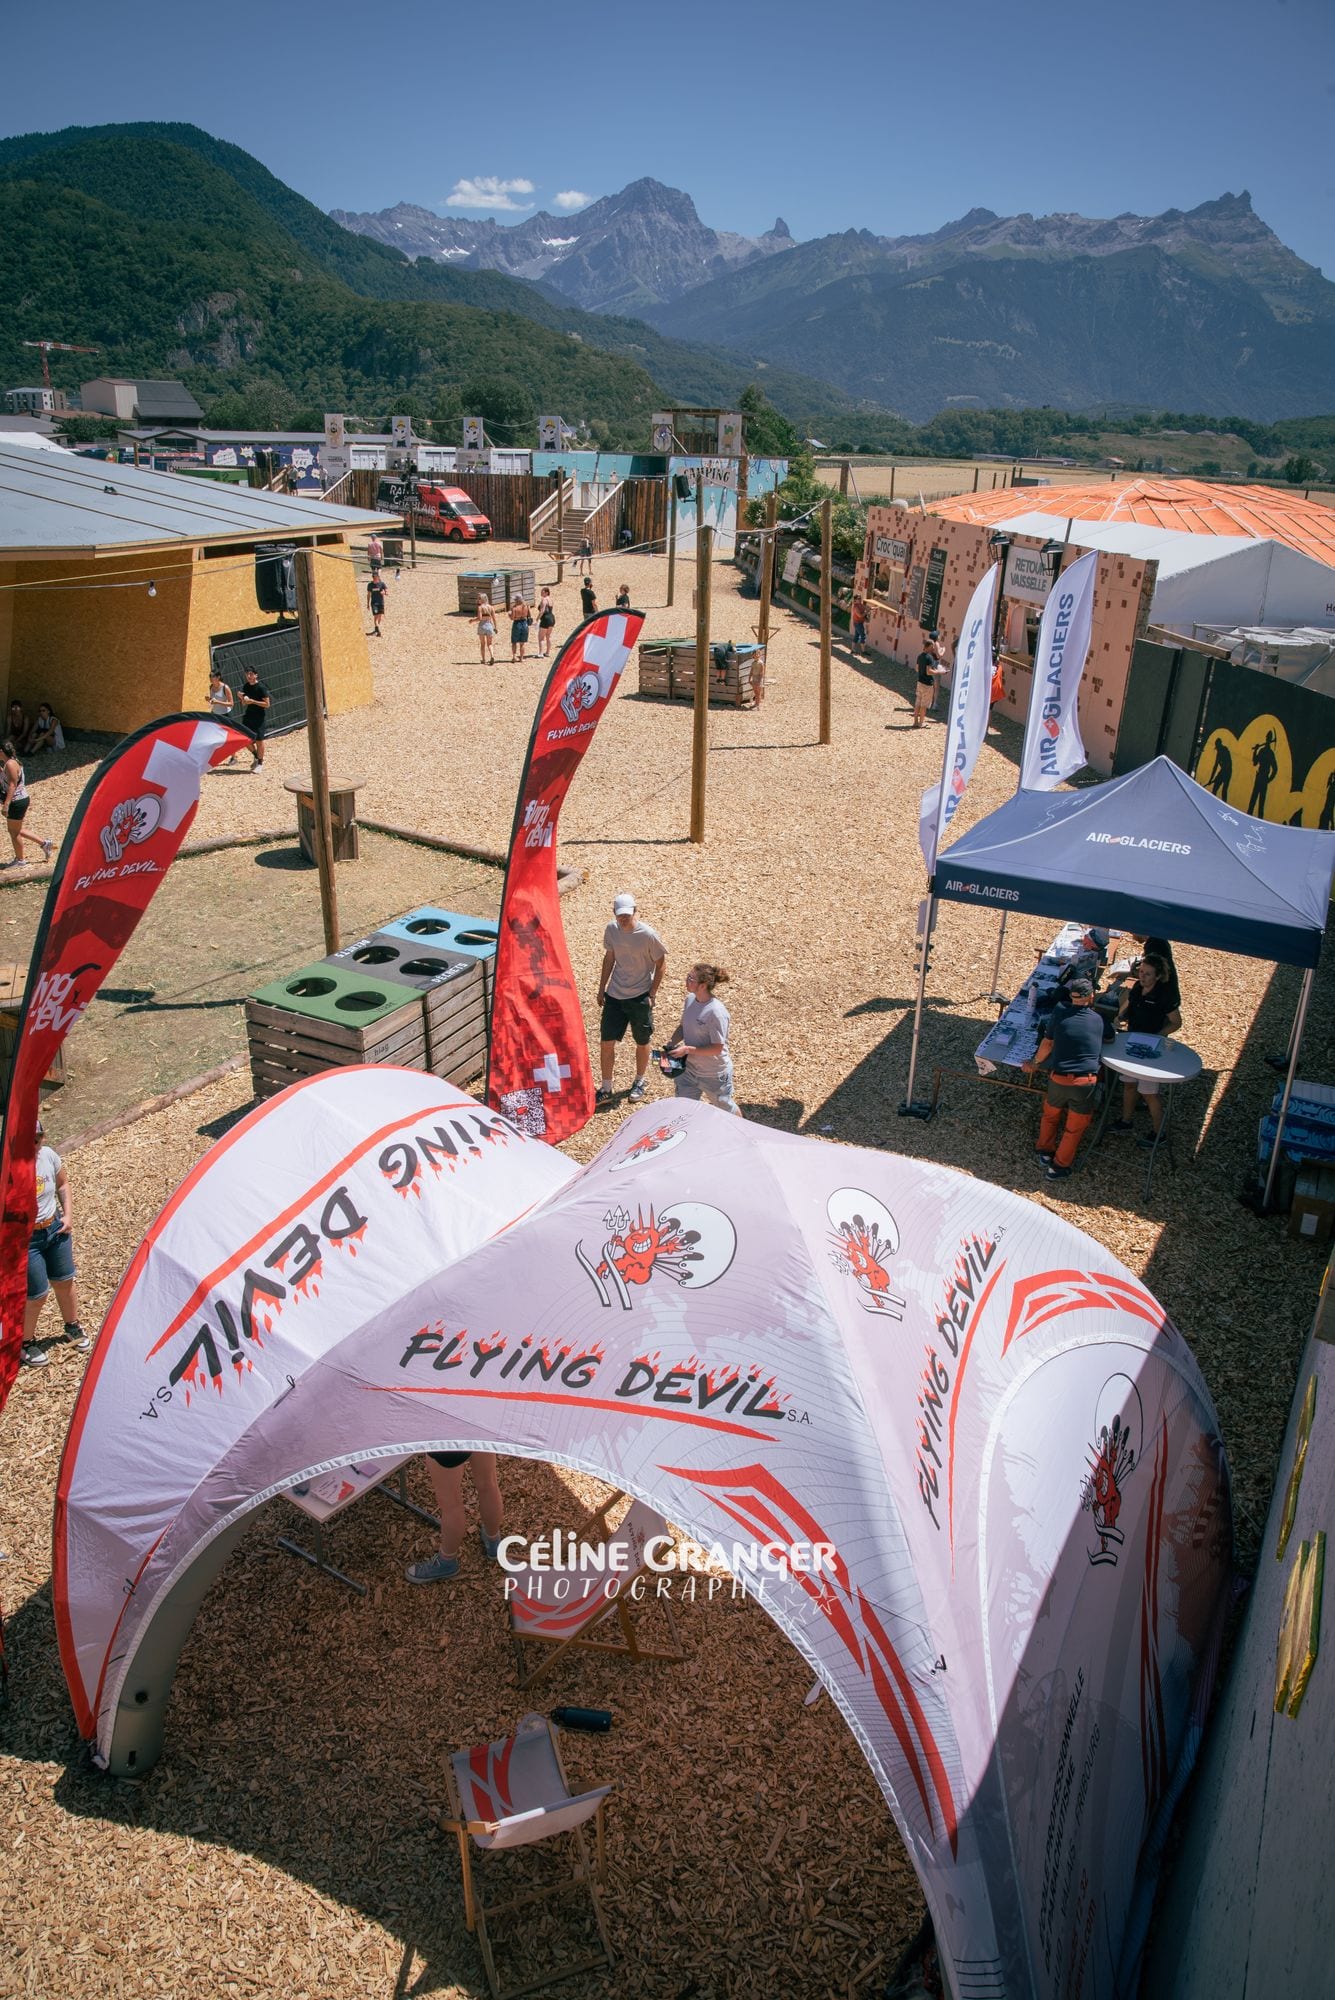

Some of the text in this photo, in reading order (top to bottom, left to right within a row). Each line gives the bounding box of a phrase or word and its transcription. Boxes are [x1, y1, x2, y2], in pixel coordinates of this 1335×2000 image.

[683, 467, 731, 483] CAMPING
[1010, 572, 1048, 592] VAISSELLE
[1015, 557, 1045, 576] RETOUR
[1040, 593, 1074, 776] AIR GLACIERS
[1085, 832, 1192, 856] AIR GLACIERS
[945, 879, 1020, 902] AIR GLACIERS
[399, 1327, 814, 1425] FLYING DEVIL S.A.
[139, 1385, 173, 1420] S.A.
[1045, 1666, 1085, 1864] PROFESSIONNELLE
[1075, 1723, 1101, 1827] FRIBOURG
[1047, 1756, 1076, 1934] PARACHUTISME
